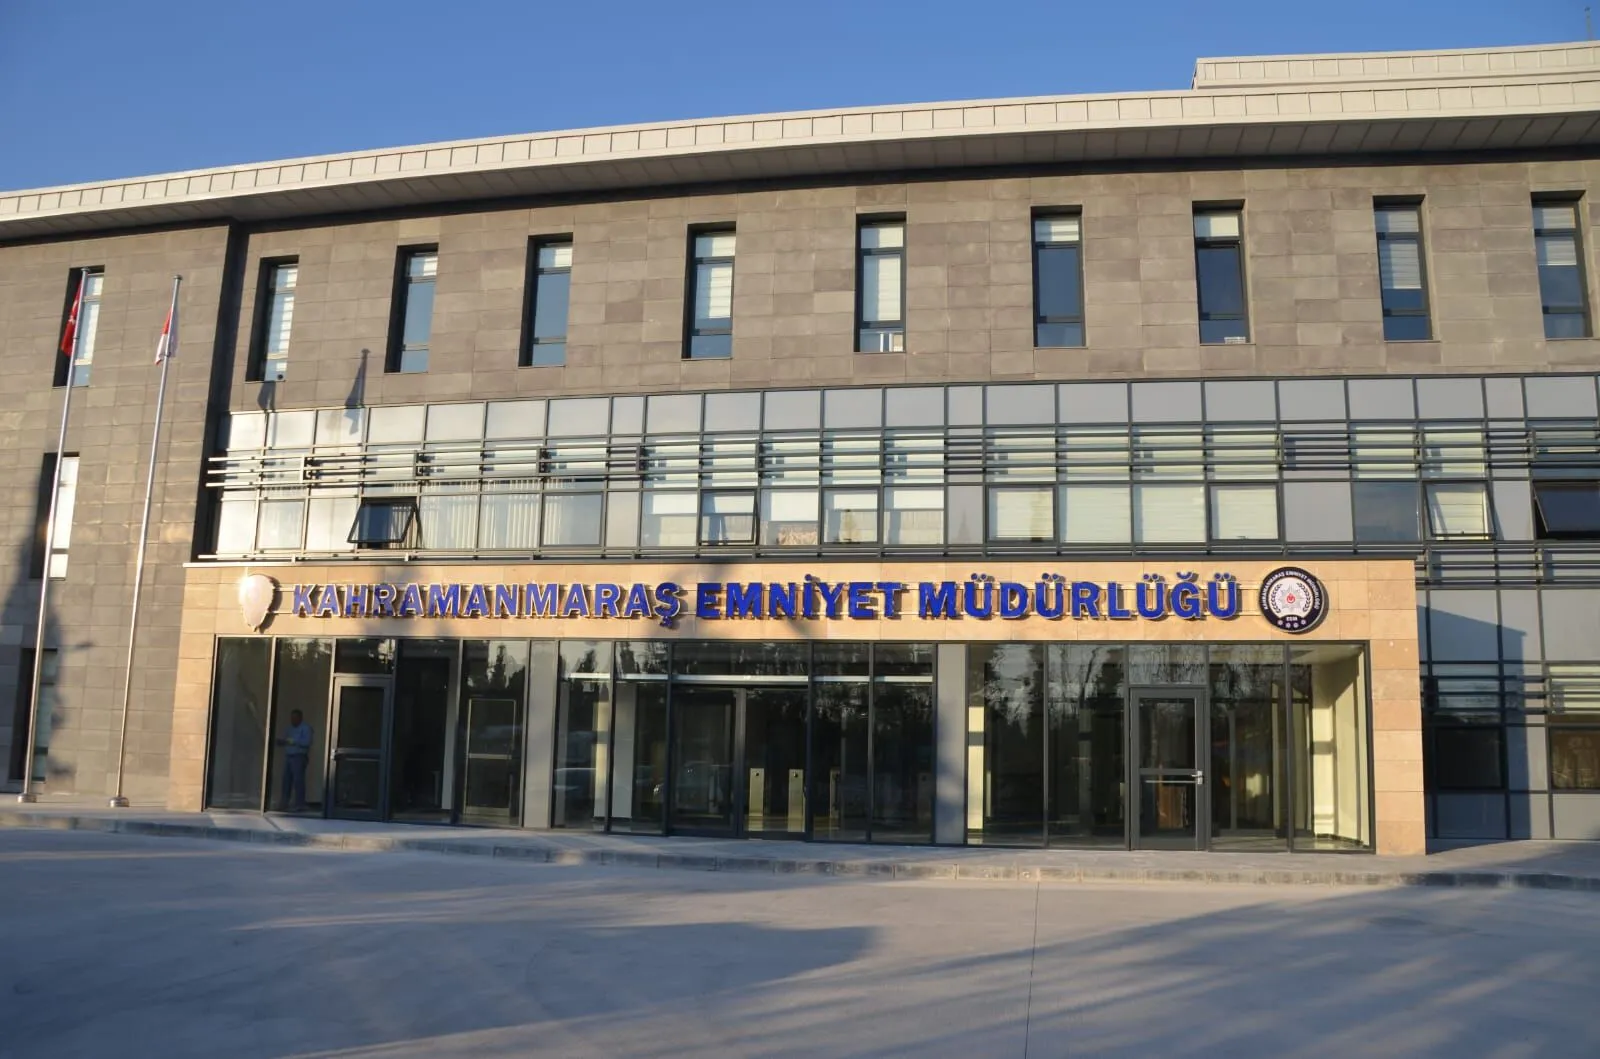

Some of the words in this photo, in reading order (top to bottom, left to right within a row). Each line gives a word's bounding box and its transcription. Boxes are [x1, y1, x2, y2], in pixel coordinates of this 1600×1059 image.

[293, 581, 681, 627] KAHRAMANMARAŞ
[696, 573, 902, 619] EMNİYET
[919, 571, 1238, 620] MÜDÜRLÜĞÜ
